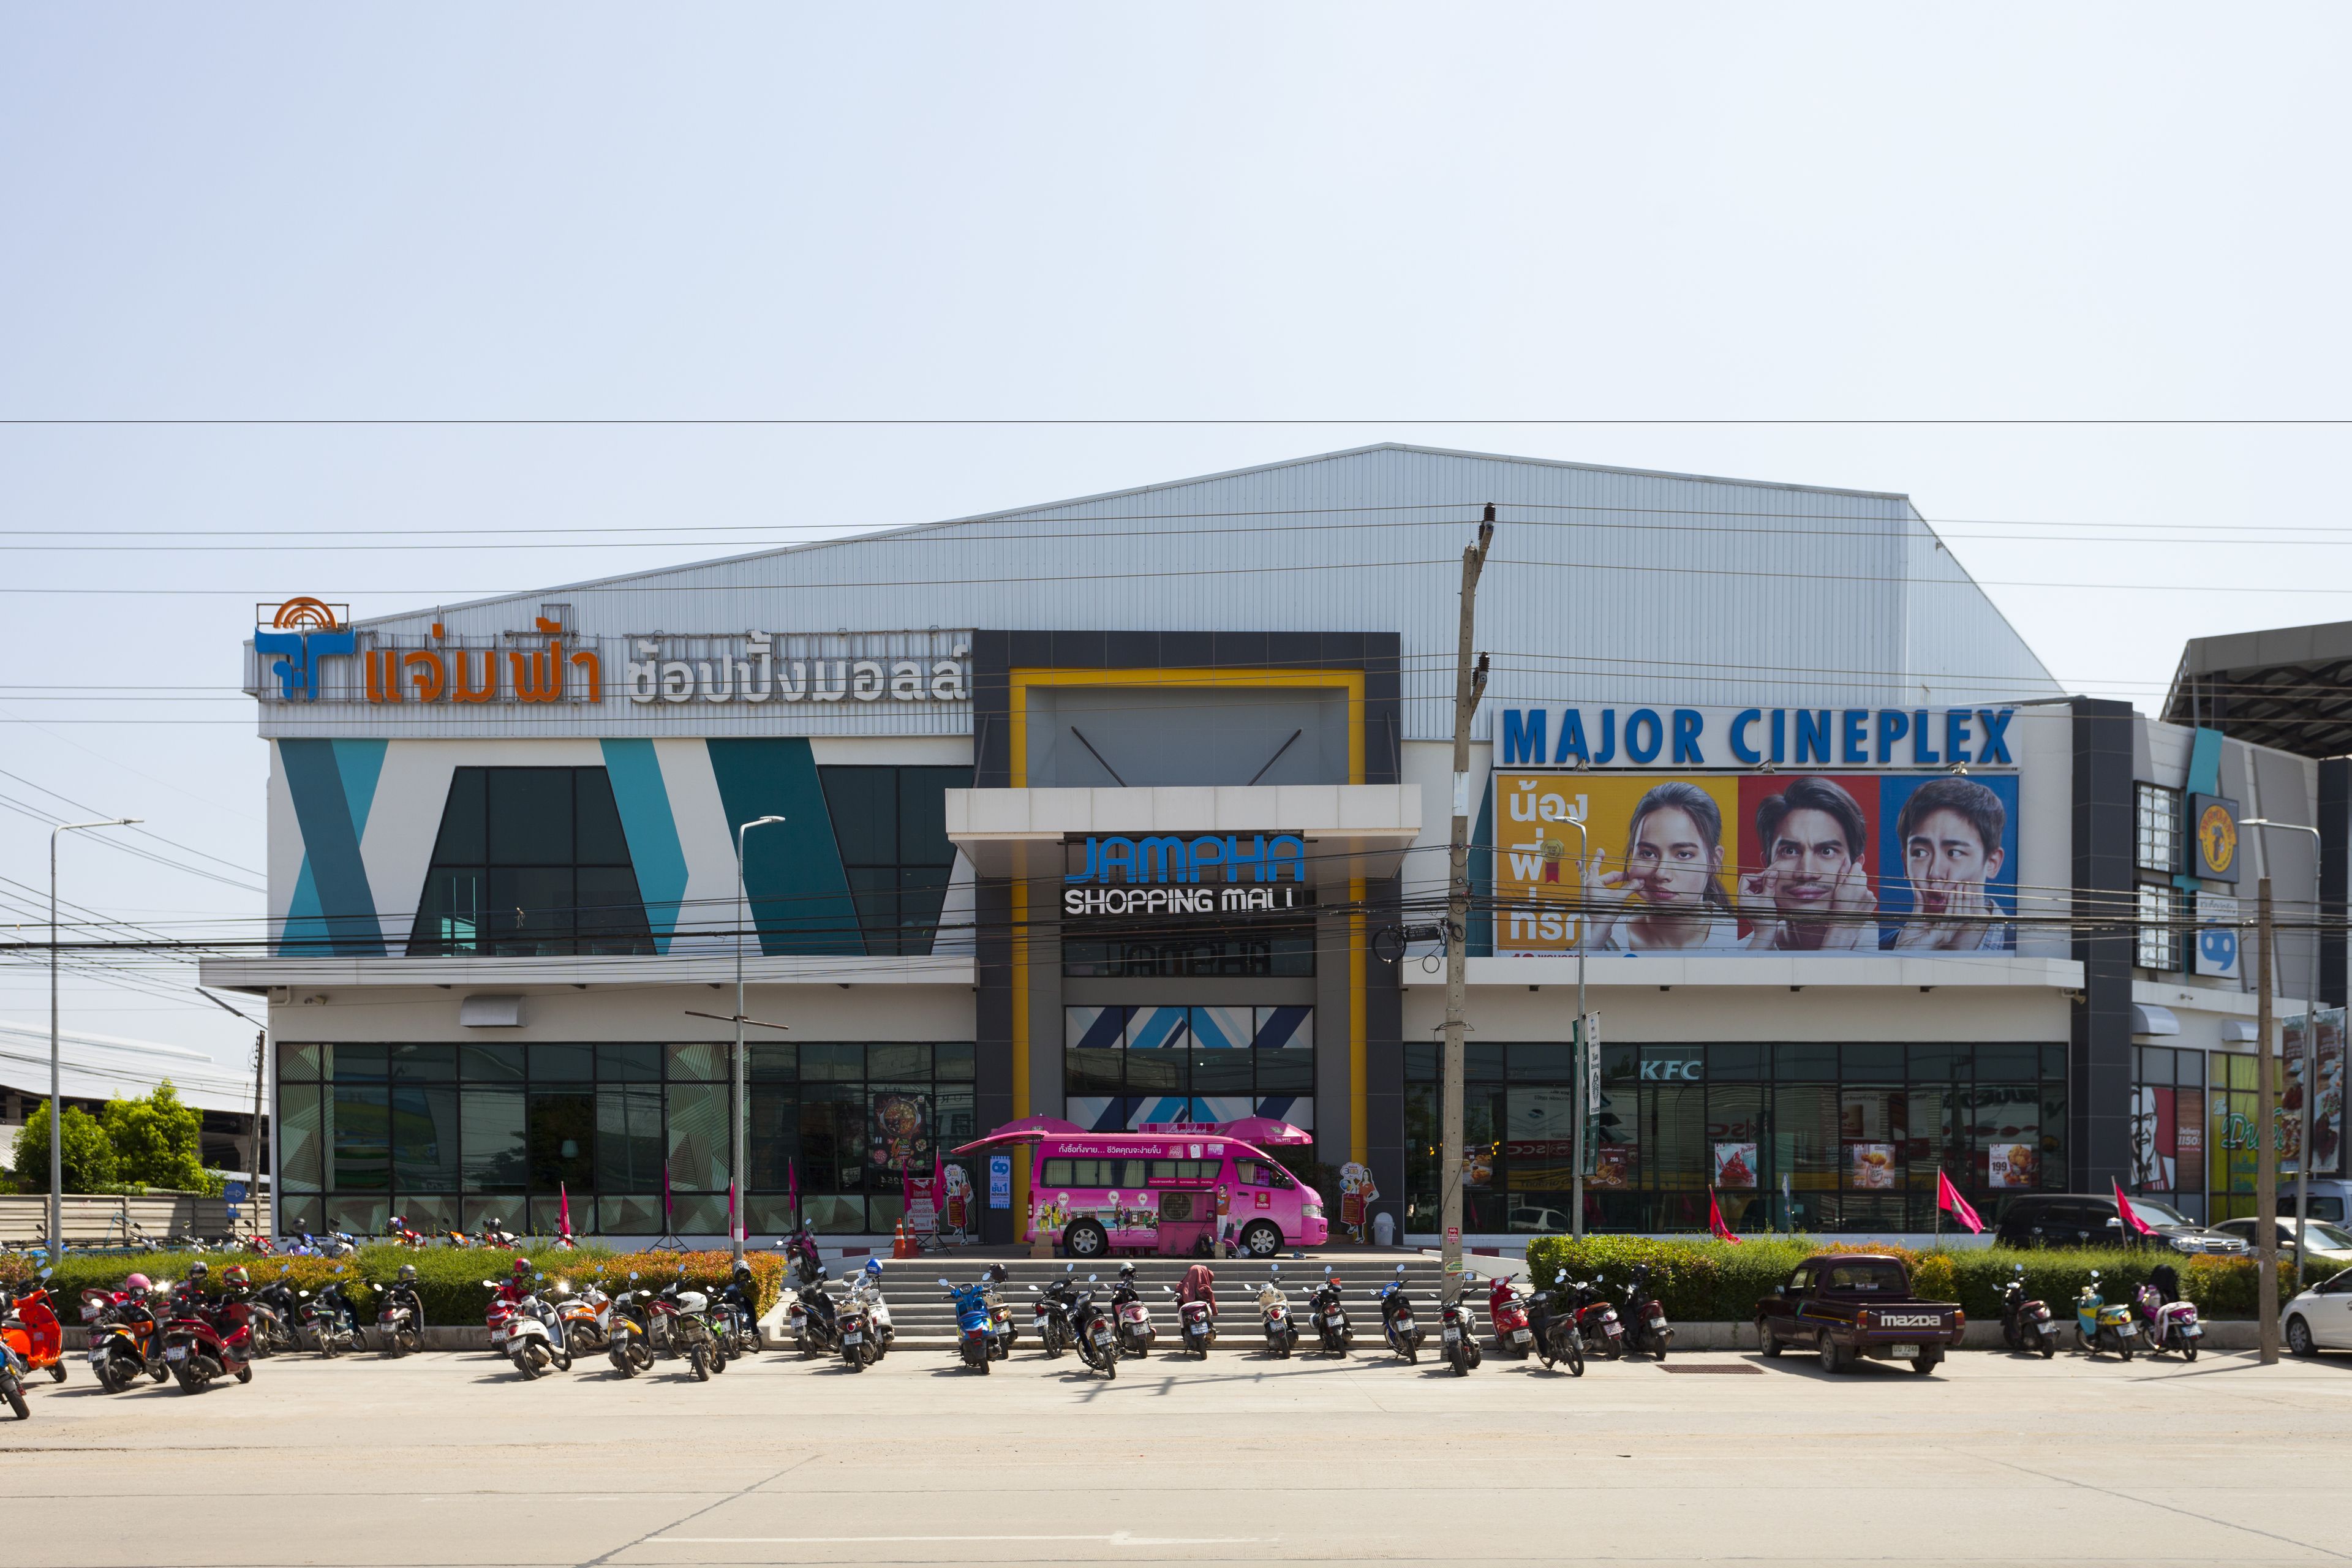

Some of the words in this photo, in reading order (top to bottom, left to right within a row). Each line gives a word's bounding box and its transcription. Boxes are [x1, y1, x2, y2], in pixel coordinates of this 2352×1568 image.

[366, 617, 600, 703] แจ่มฟ้า
[628, 630, 970, 703] ช้อปปิ้งมอลล์
[1504, 709, 1705, 764] MAJOR
[1730, 709, 2013, 764] CINEPLEX
[1510, 780, 1588, 823] น้อง
[1065, 834, 1305, 883] JAMPHA
[1065, 889, 1213, 914] SHOPPING
[1640, 1060, 1702, 1080] KFC
[1107, 1144, 1161, 1155] ชีวิตคุณจะง่ายขึ้น
[2178, 1136, 2198, 1145] 1150
[1991, 1161, 2007, 1171] 199
